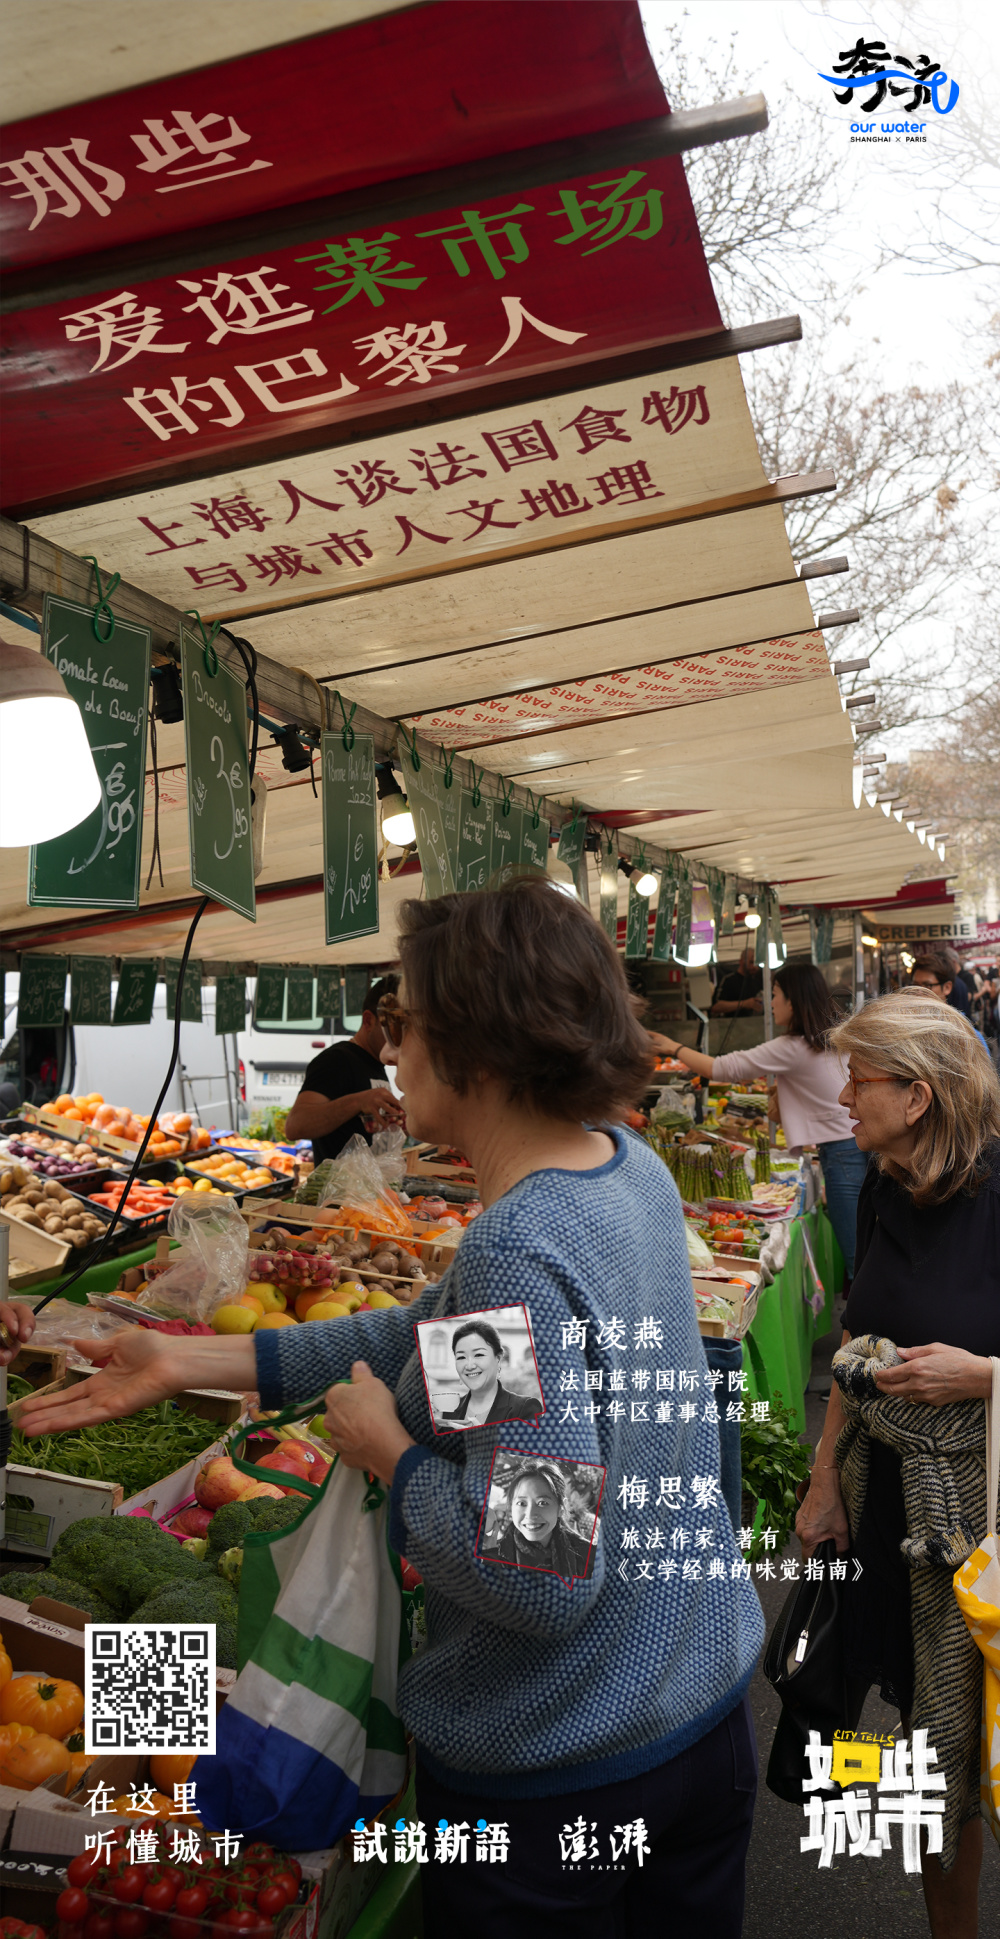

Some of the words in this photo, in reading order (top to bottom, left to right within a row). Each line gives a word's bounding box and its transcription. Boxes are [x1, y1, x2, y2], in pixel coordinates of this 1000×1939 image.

[49, 634, 98, 684] Tomate
[716, 655, 760, 669] PARIS
[760, 650, 802, 662] PARIS
[672, 659, 717, 676] PARIS
[763, 663, 806, 672] PARIS
[679, 676, 722, 686] PARIS
[721, 670, 764, 680] PARIS
[592, 683, 638, 699] PARIS
[635, 681, 680, 693] PARIS
[507, 693, 553, 710] PARI
[549, 687, 596, 705] PARIS
[84, 690, 102, 714] de
[109, 699, 144, 736] Boeuf
[515, 709, 560, 719] PARIS
[558, 705, 601, 713] PARIS
[430, 717, 475, 729] PARIS
[472, 713, 517, 724] PARIS
[880, 923, 971, 940] CREPERIE
